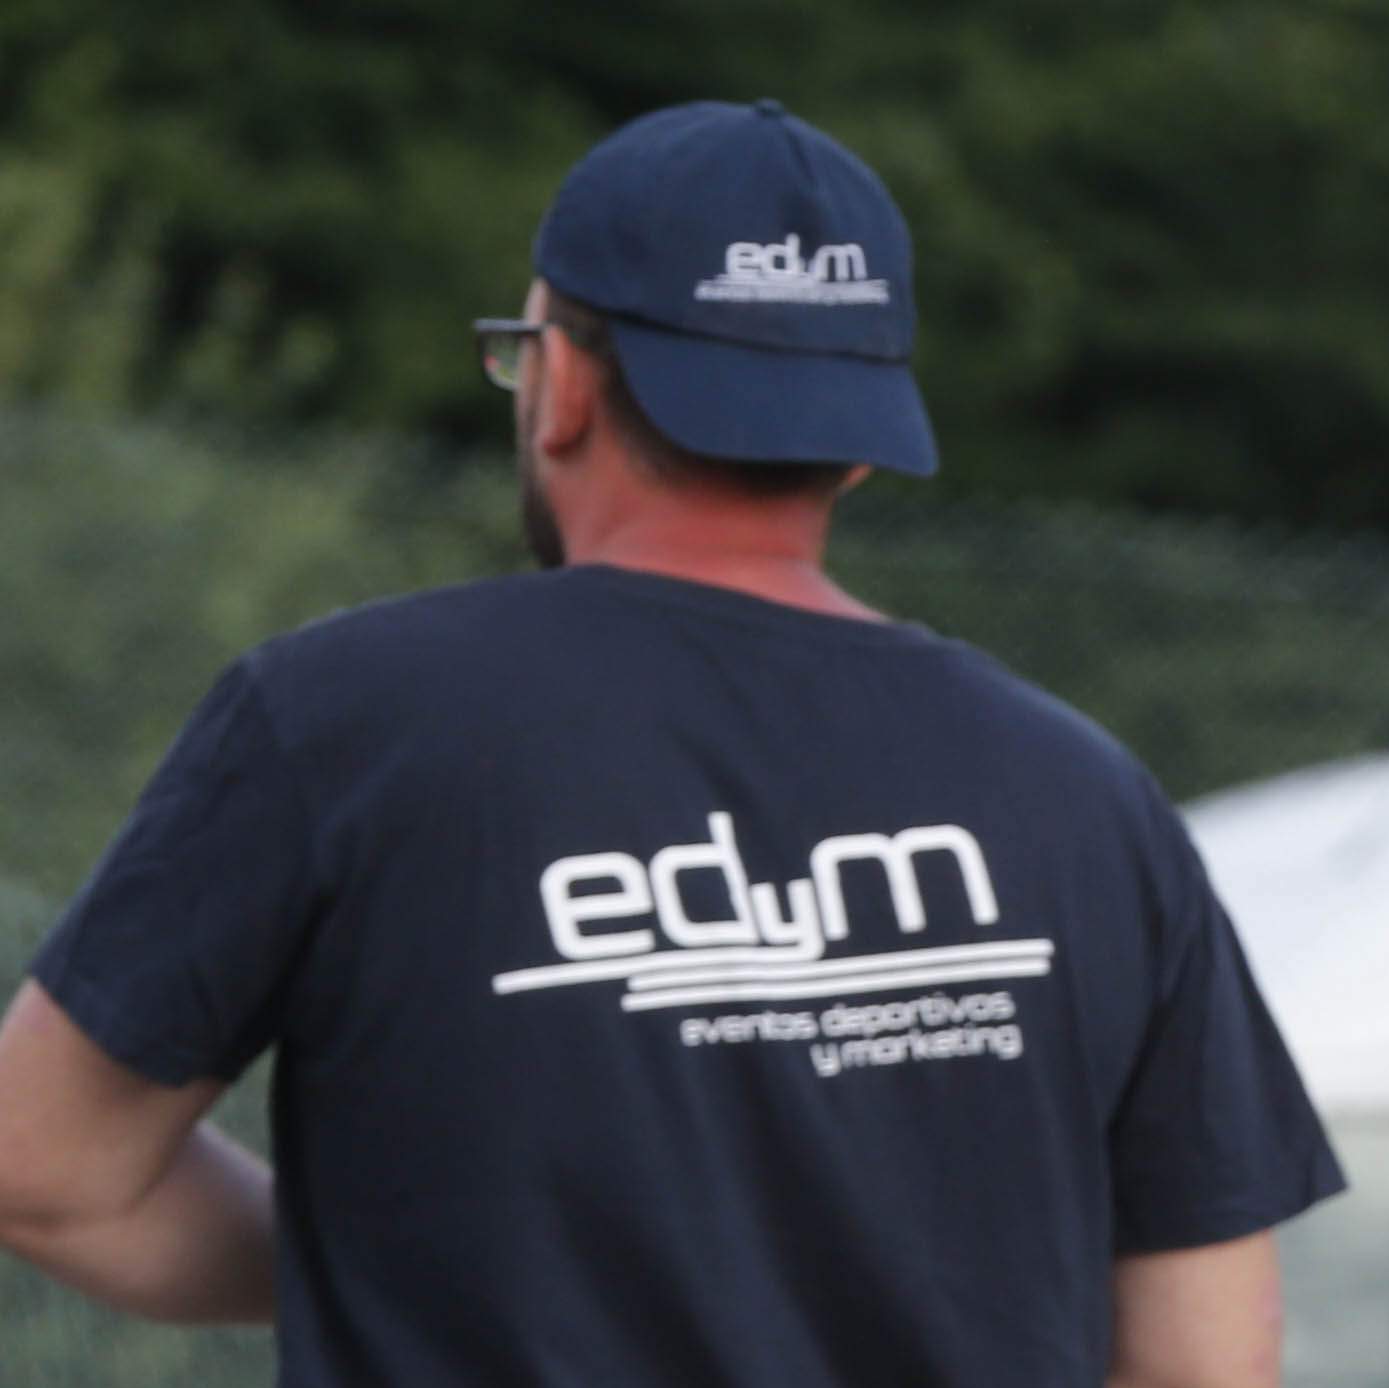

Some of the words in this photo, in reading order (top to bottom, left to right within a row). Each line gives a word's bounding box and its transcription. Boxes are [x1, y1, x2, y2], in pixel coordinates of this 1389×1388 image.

[540, 811, 998, 960] edym
[680, 1009, 819, 1048] eventos
[820, 990, 1016, 1039] deportivos
[809, 1042, 841, 1077] y
[841, 1022, 1024, 1069] marketing
